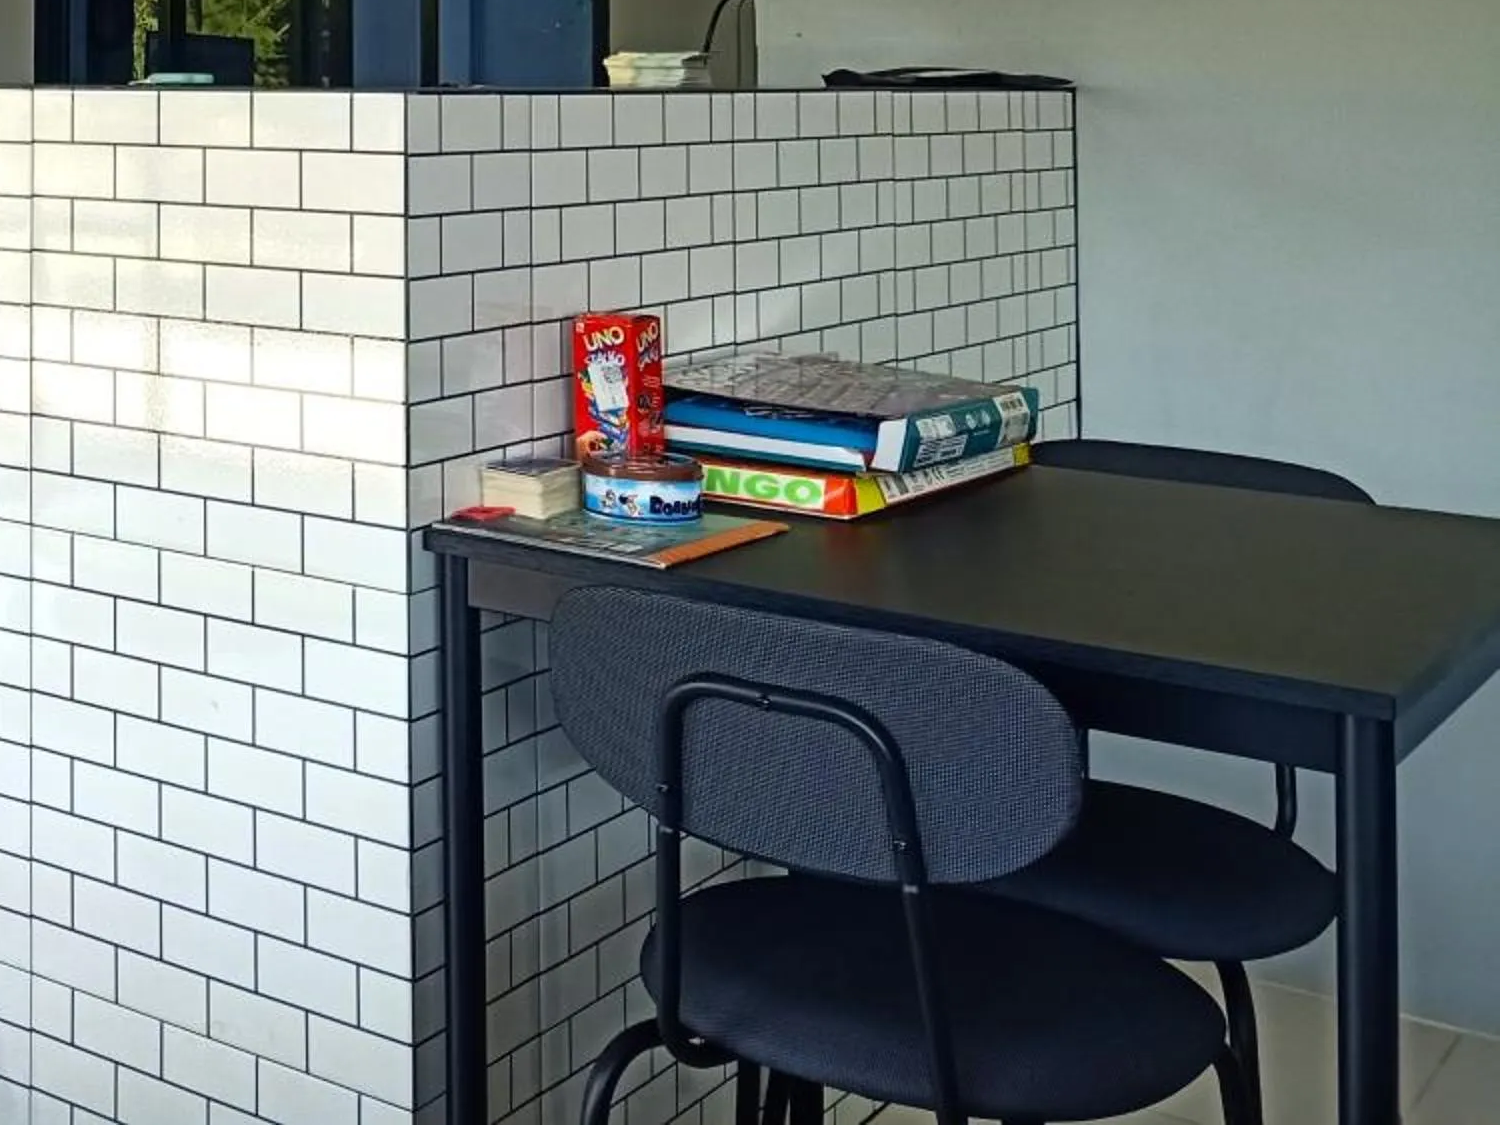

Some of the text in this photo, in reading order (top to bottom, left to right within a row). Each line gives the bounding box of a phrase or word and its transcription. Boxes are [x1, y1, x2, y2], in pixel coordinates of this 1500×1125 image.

[583, 325, 625, 352] UNO
[636, 322, 659, 353] UNO
[705, 467, 823, 505] NGO
